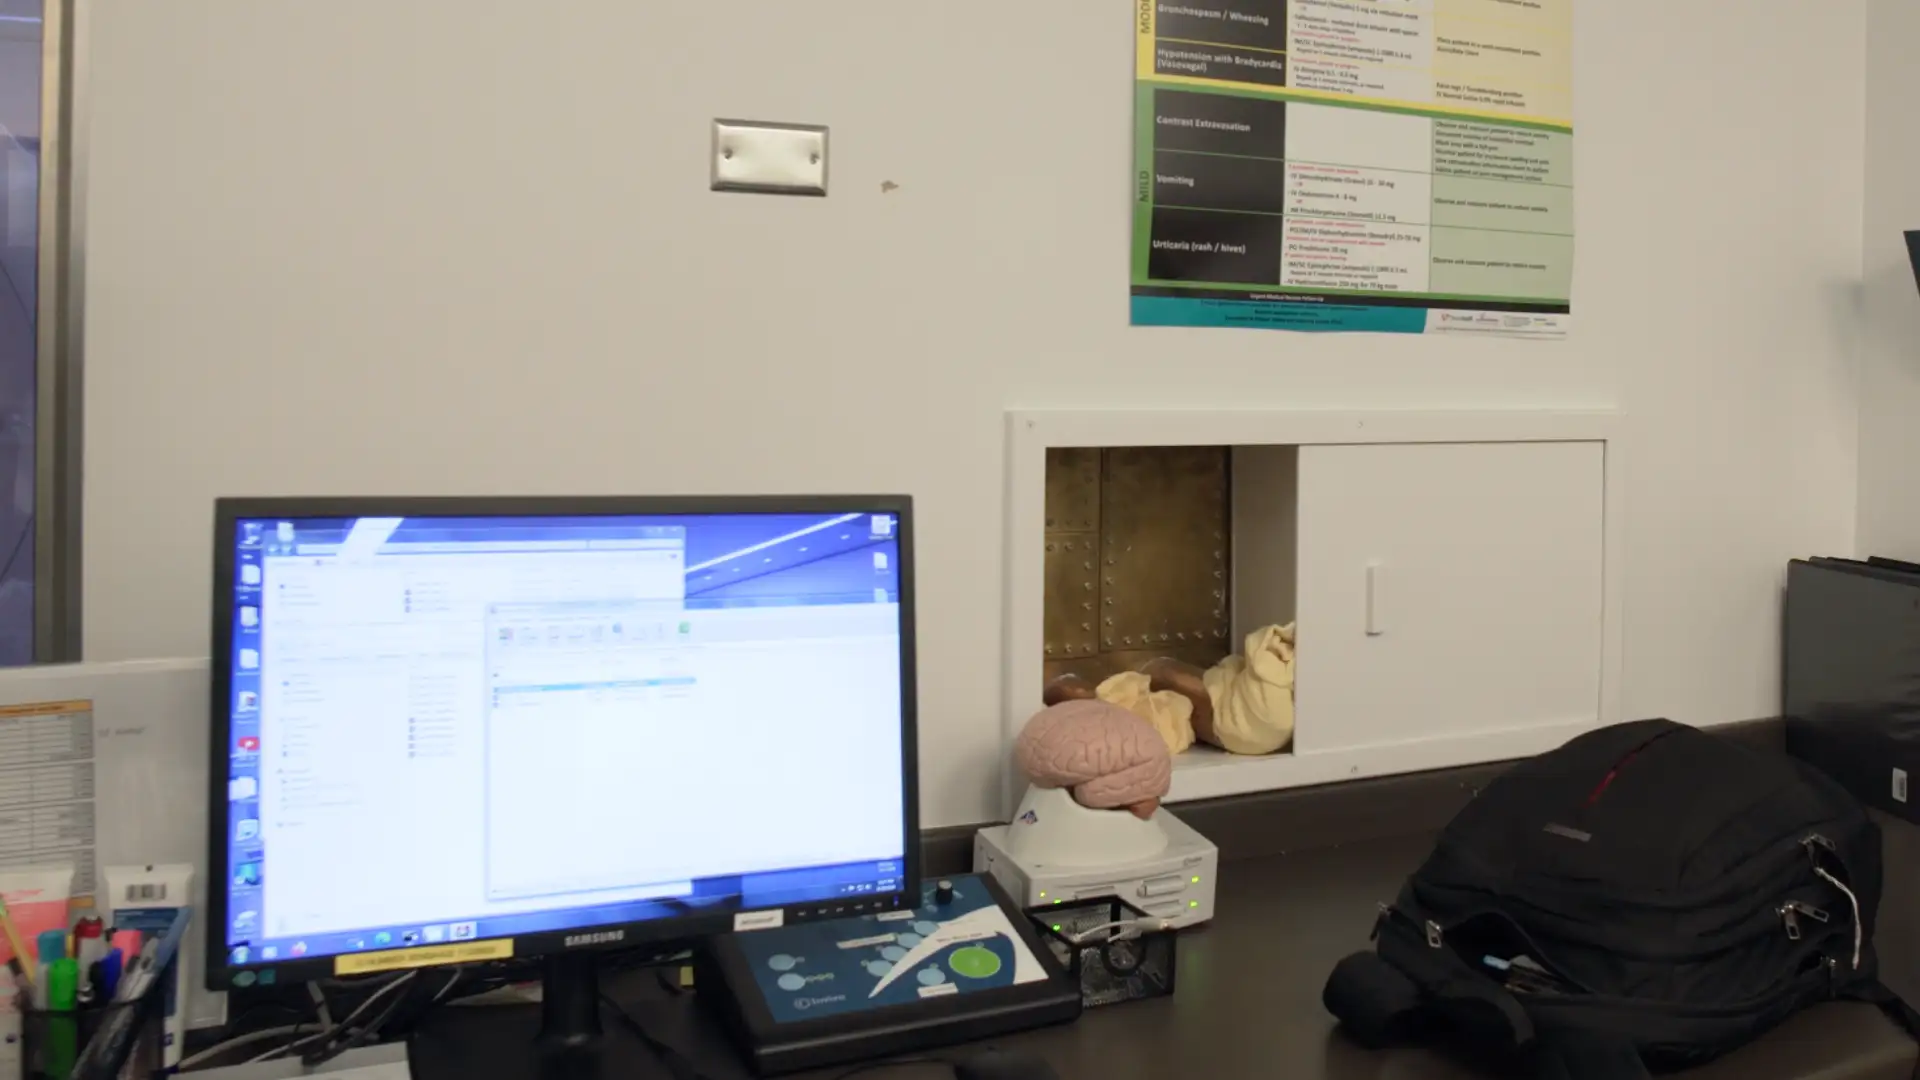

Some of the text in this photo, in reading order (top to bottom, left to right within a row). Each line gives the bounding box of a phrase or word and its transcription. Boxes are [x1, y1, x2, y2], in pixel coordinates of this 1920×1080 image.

[1158, 4, 1221, 19] Bronchospasm
[1229, 11, 1269, 26] Wheezing
[1157, 58, 1207, 73] (Vasovagal)
[1158, 49, 1212, 62] Hypotension
[1214, 54, 1233, 63] with
[1234, 56, 1282, 69] Bradycardia
[1156, 115, 1251, 132] Contrast Extravasation
[1139, 170, 1150, 202] MILD
[1156, 173, 1195, 188] Vomiting
[1153, 239, 1190, 251] Urticaria
[1191, 241, 1213, 252] (rash
[1220, 243, 1246, 254] hives)
[565, 930, 624, 947] SAMSUNG
